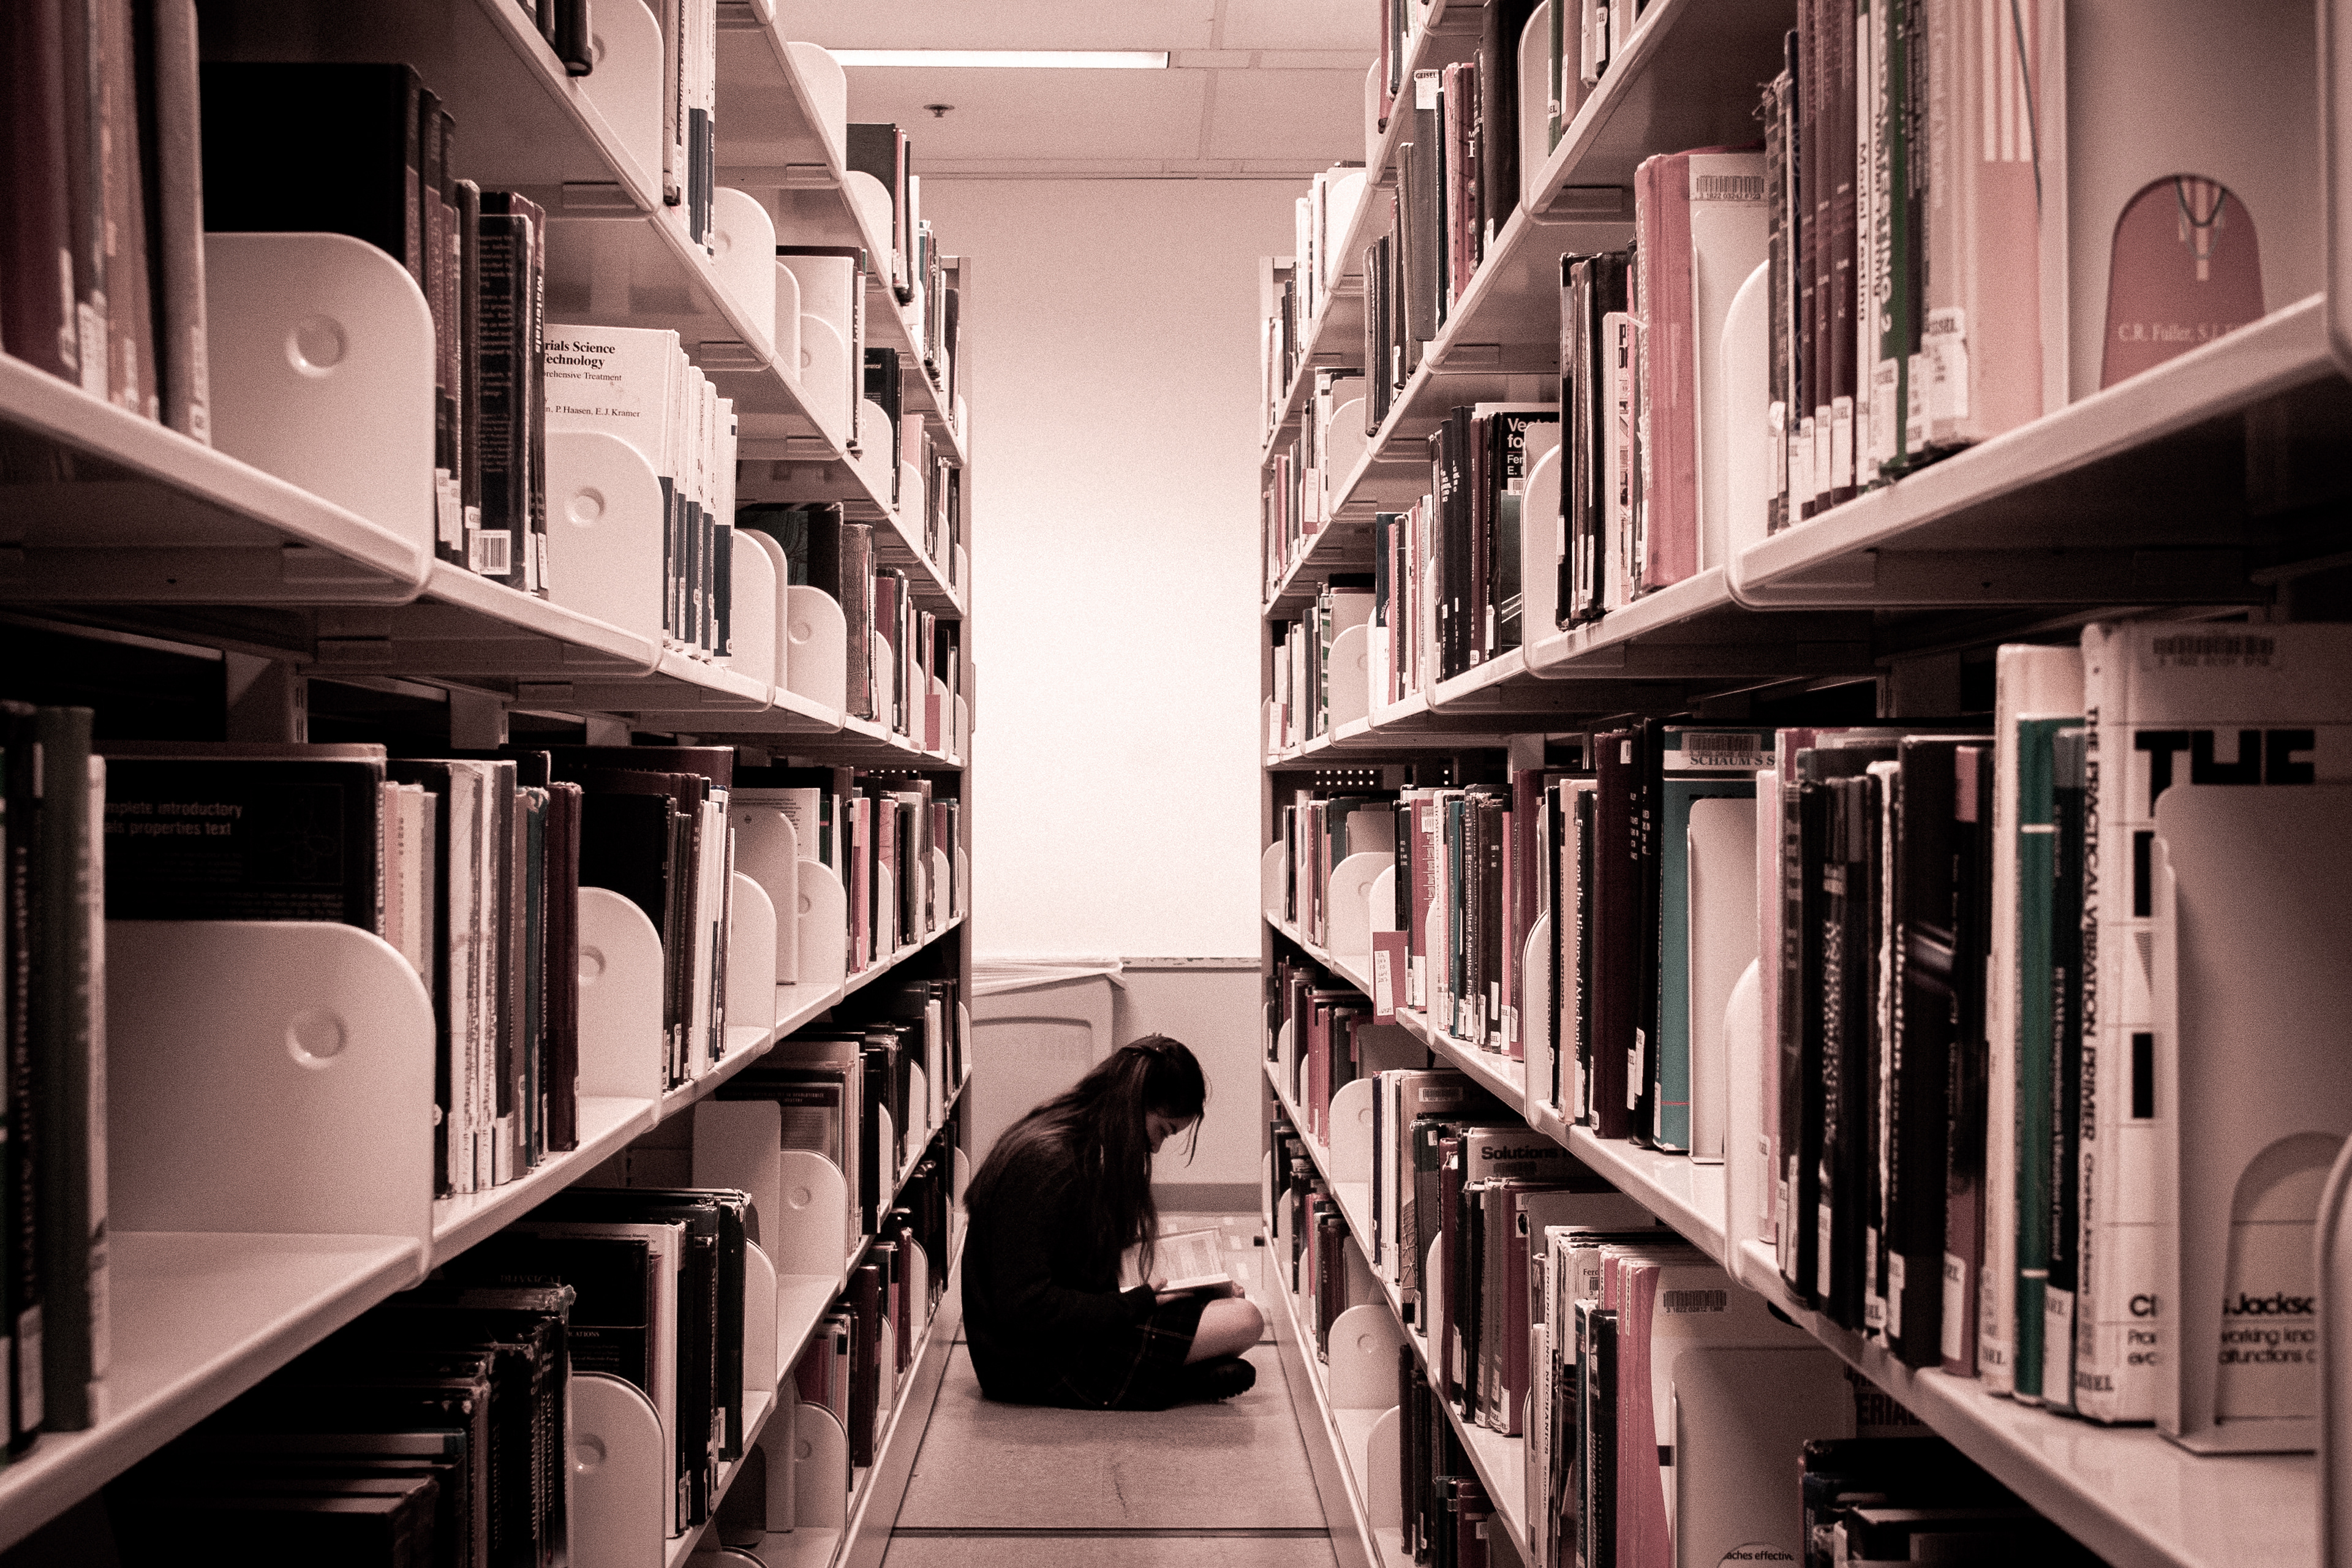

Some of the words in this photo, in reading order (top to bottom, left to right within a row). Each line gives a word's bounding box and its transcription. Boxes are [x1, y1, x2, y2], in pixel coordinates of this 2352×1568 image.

[1859, 143, 1868, 220] Modal
[1879, 146, 1892, 304] TESTING
[1858, 233, 1868, 322] Testing
[535, 275, 544, 354] Materials
[1880, 313, 1892, 333] 2
[545, 341, 570, 352] rials
[573, 341, 616, 354] Science
[546, 371, 581, 379] rehensive
[584, 372, 622, 381] Treatment
[563, 406, 594, 416] Haasen,
[612, 409, 641, 418] Kramer
[1507, 434, 1523, 448] fo
[2086, 706, 2100, 752] THE
[1691, 755, 1763, 766] SCHAUM'S
[107, 801, 153, 815] mplete
[157, 801, 243, 820] introductory
[129, 820, 202, 837] properties
[205, 821, 232, 835] text
[2086, 761, 2098, 898] PRACTICAL
[1575, 914, 1583, 963] History
[2084, 906, 2098, 1038] VIBRATION
[1575, 985, 1583, 1061] Mechanics
[2081, 1046, 2097, 1142] PRIMER
[1482, 1145, 1558, 1160] Solutions
[2217, 1349, 2303, 1365] alfunctions
